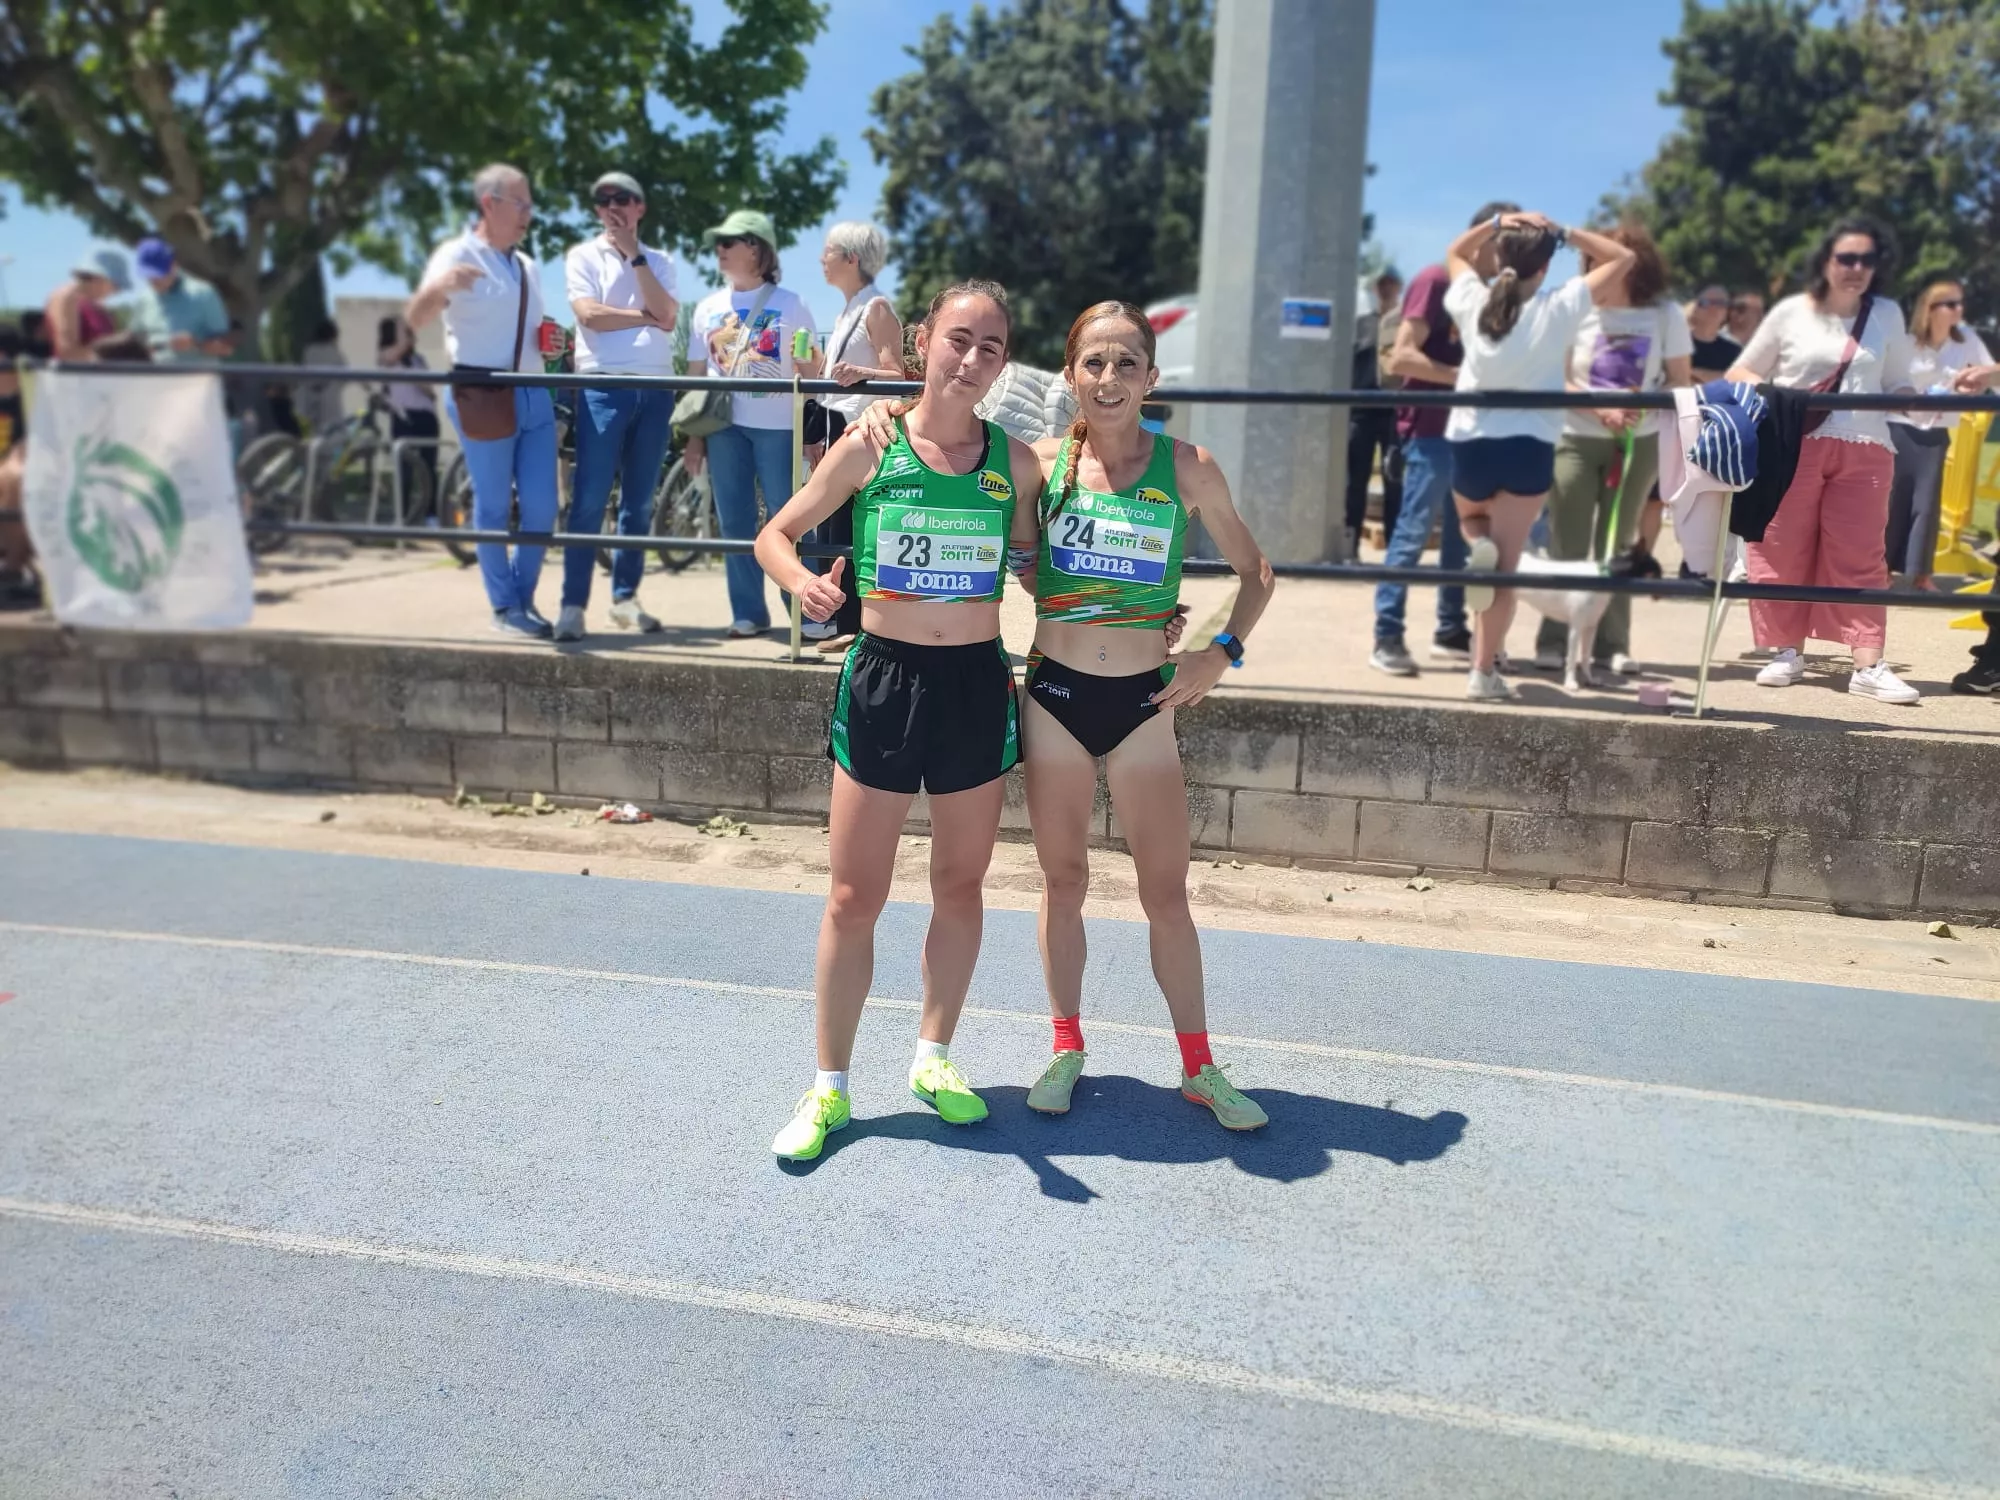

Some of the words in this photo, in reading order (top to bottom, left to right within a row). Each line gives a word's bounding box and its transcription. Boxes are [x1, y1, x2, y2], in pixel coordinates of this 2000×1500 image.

[889, 489, 924, 499] ZOITI
[1095, 500, 1156, 521] Iberdrola
[928, 516, 987, 531] Iberdrola
[1062, 515, 1096, 550] 24
[1104, 528, 1139, 538] ATLETISMO
[1104, 534, 1138, 549] ZOITI
[897, 534, 932, 568] 23
[940, 550, 974, 561] ZOITI
